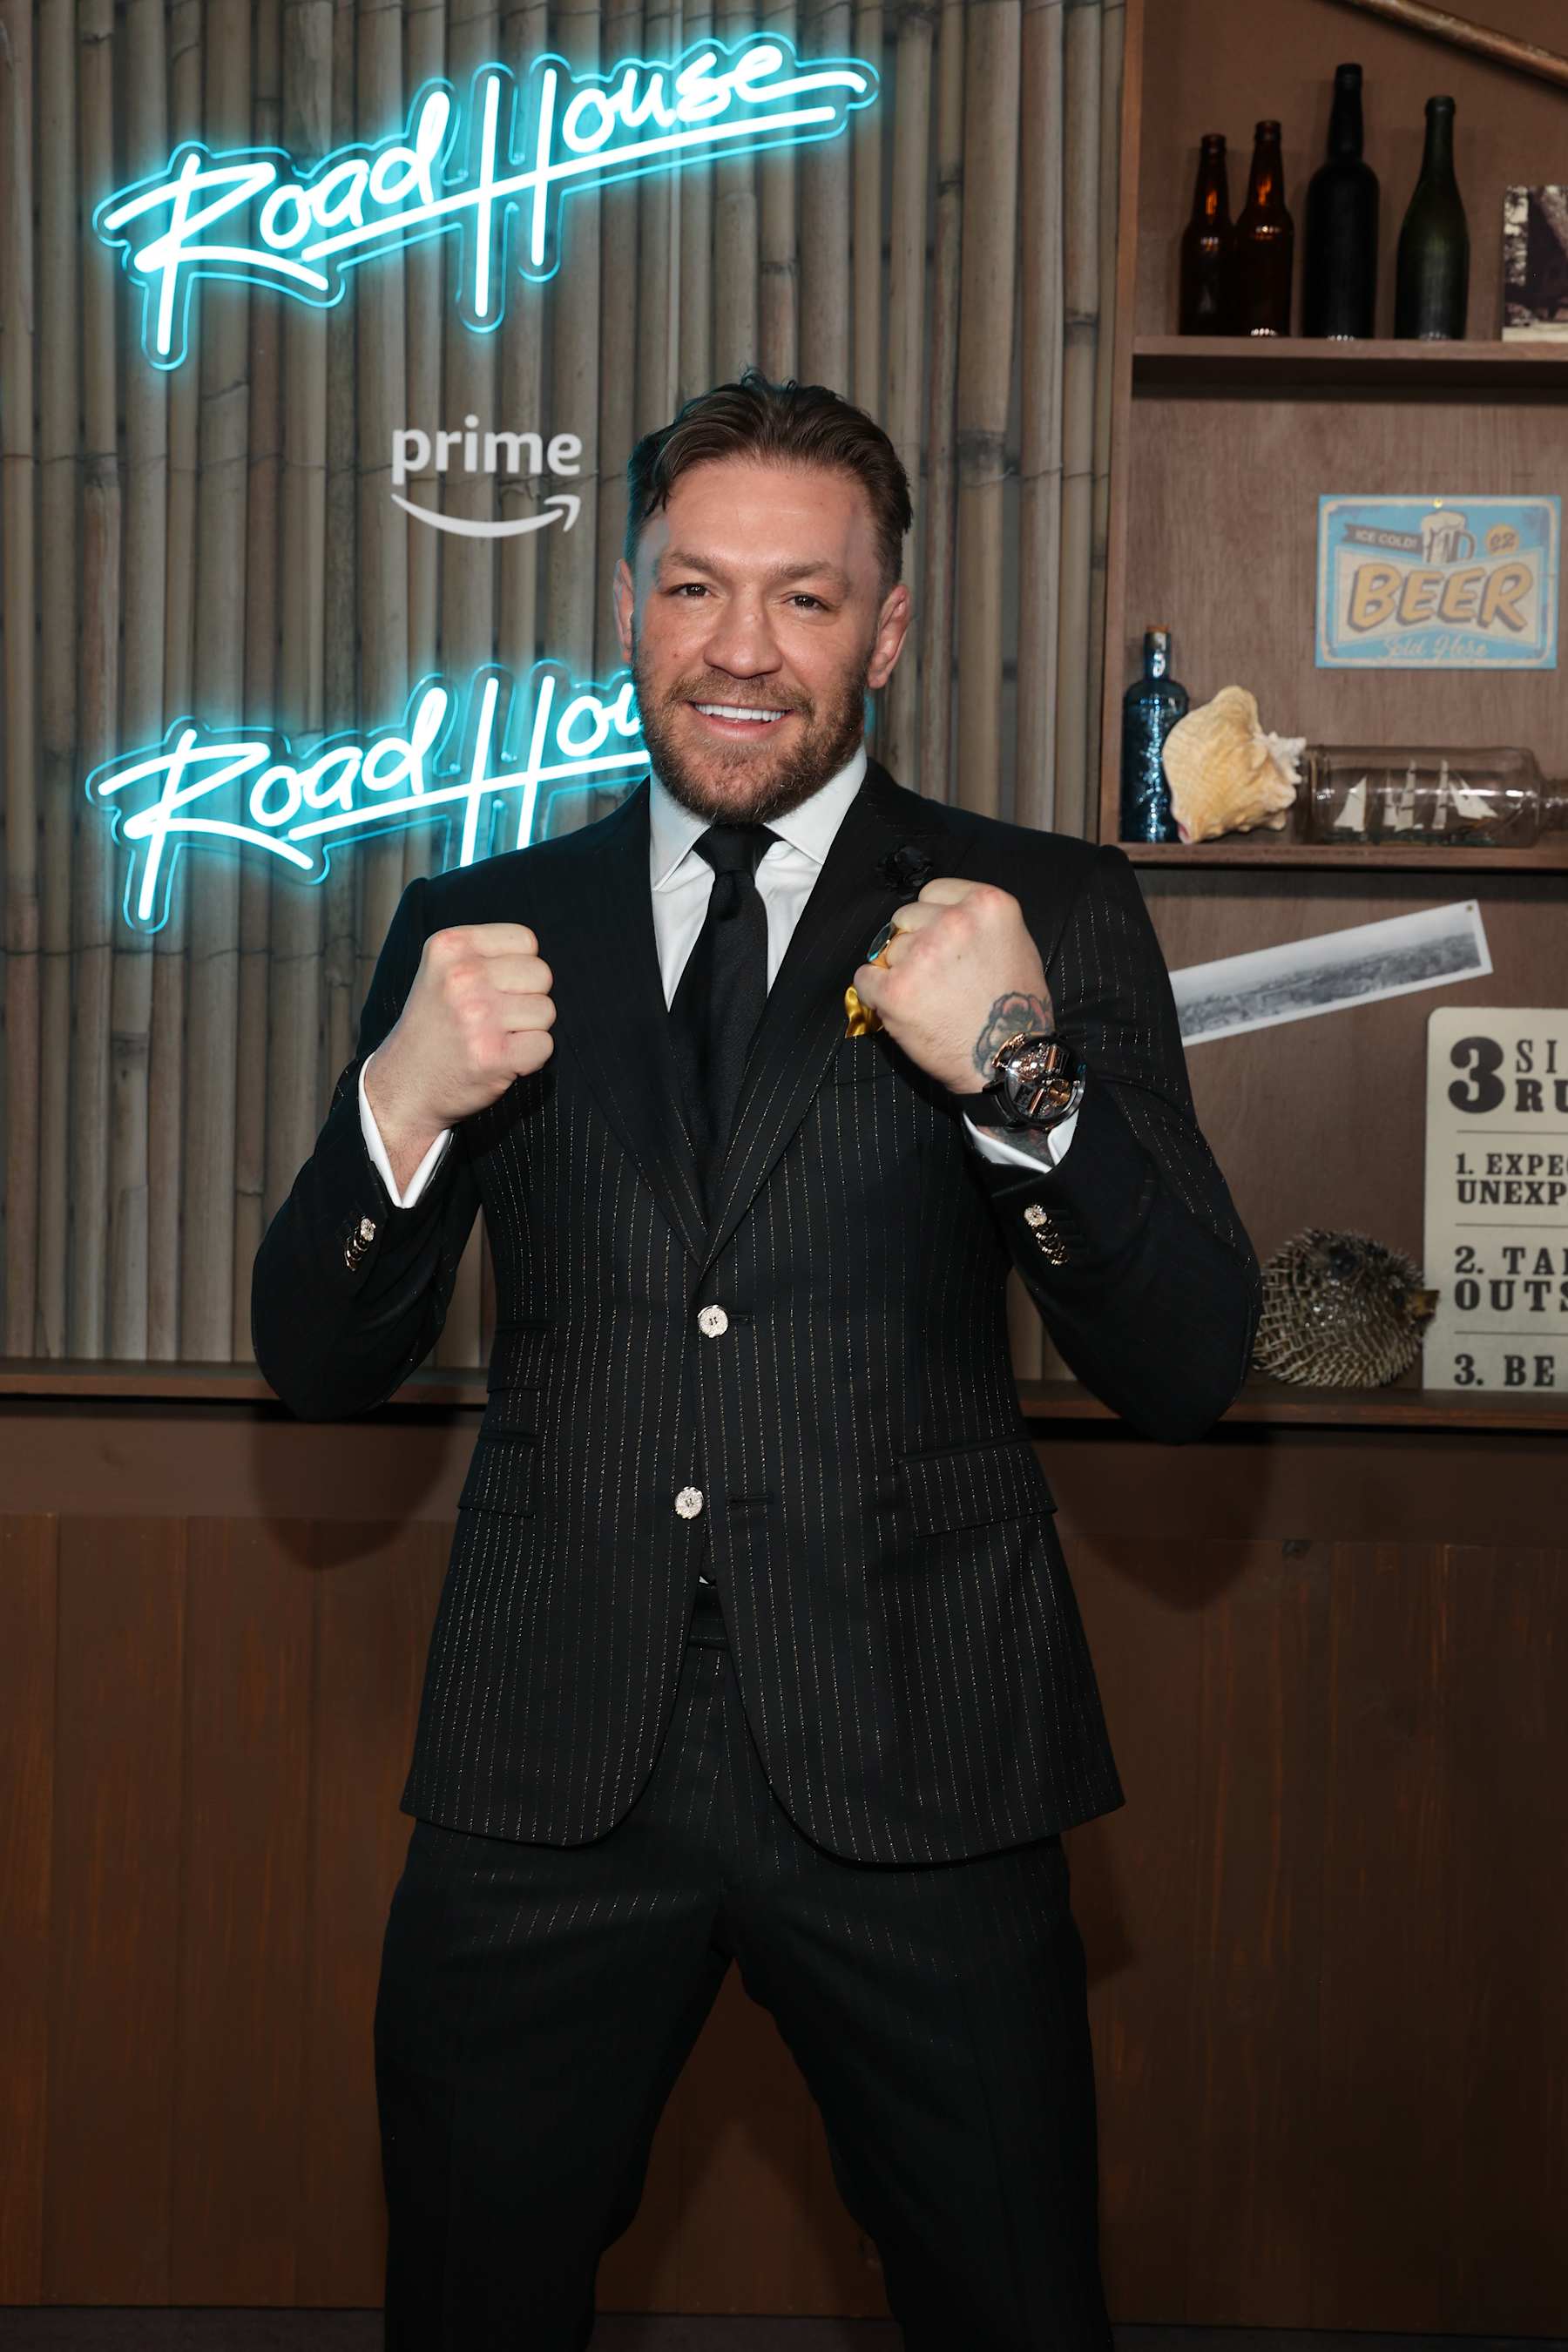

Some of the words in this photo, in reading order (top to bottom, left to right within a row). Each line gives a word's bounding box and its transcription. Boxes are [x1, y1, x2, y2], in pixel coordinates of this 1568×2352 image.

[105, 91, 450, 355] Road
[474, 44, 868, 318] House
[392, 414, 583, 486] prime
[1348, 563, 1533, 632] BEER
[98, 686, 448, 920] Road
[1448, 1036, 1506, 1114] 3
[1456, 1152, 1474, 1175] 1.
[1486, 1152, 1568, 1176] EXPE
[1454, 1245, 1484, 1274] 2.
[1502, 1247, 1568, 1275] TA
[1453, 1353, 1484, 1386] 3.
[1503, 1354, 1555, 1387] BE
